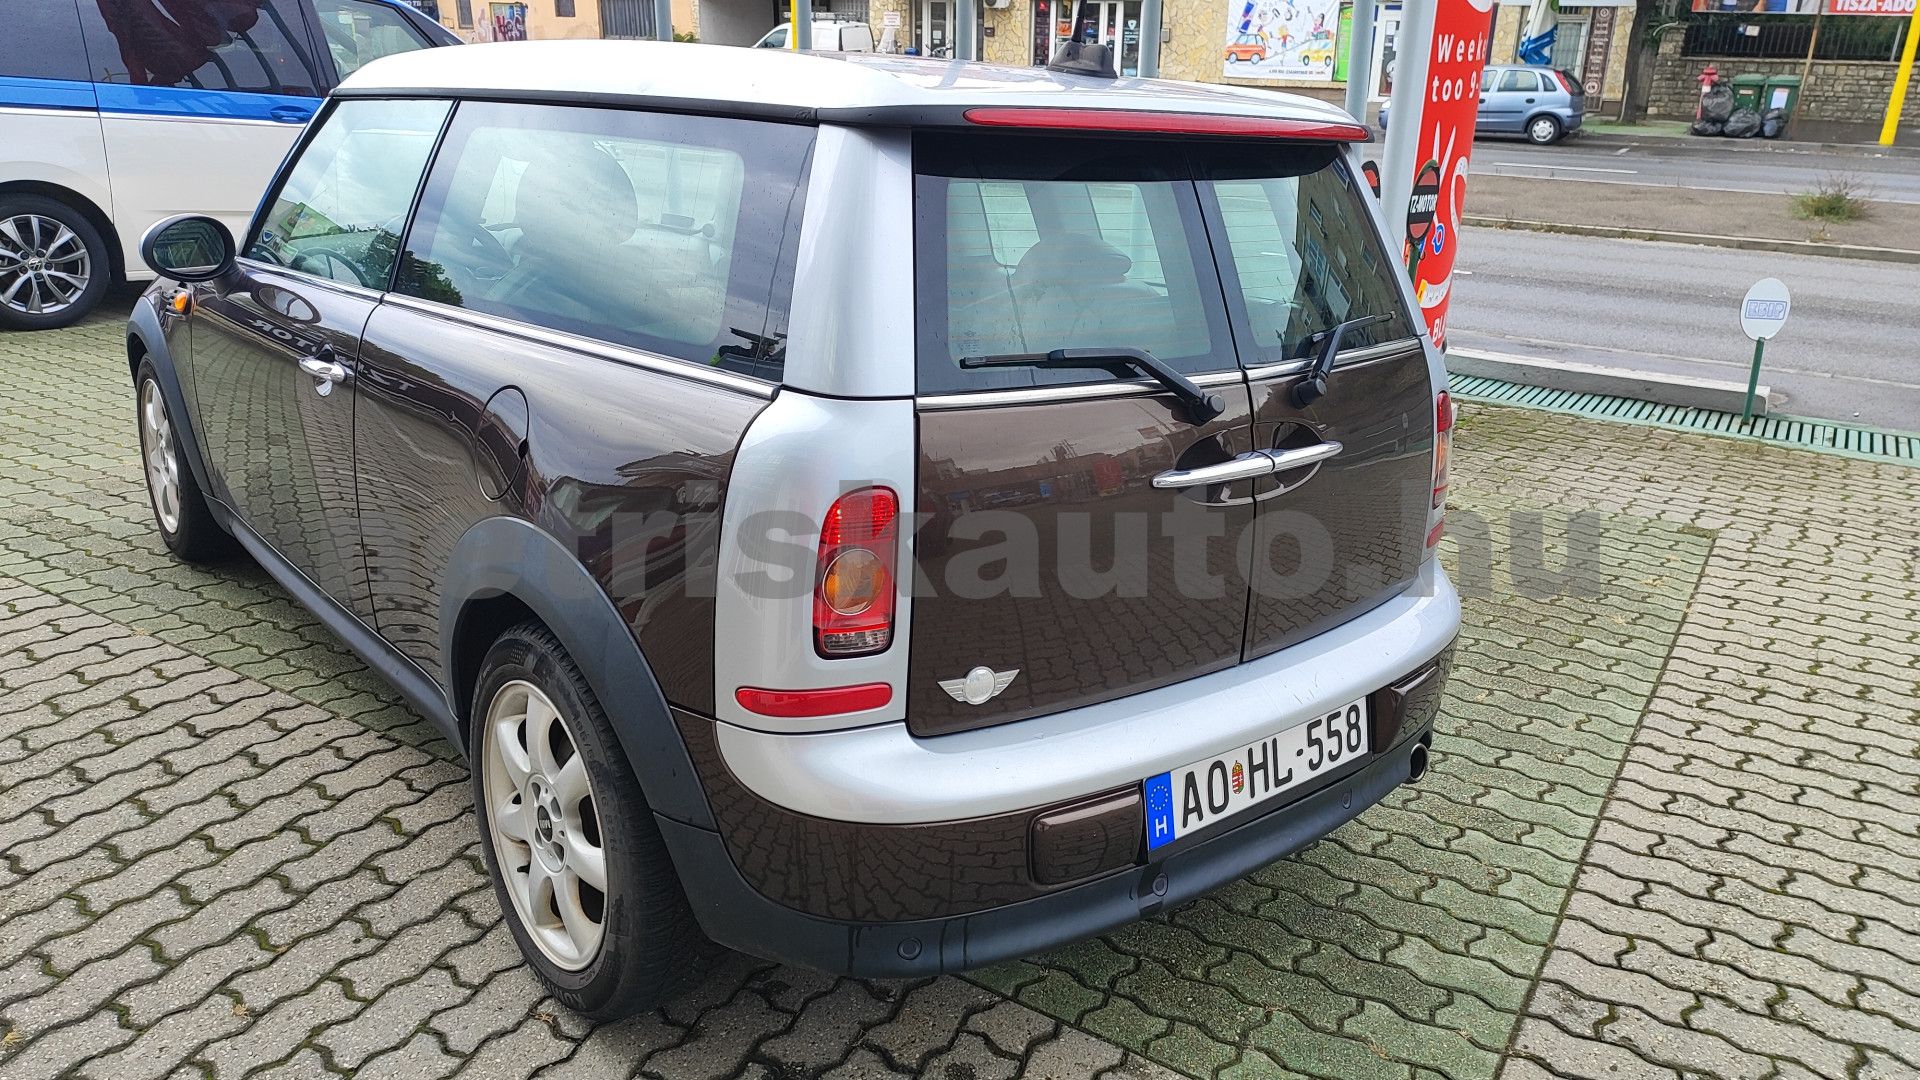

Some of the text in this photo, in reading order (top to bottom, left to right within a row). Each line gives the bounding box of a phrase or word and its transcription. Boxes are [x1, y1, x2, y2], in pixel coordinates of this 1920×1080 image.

[1432, 75, 1463, 102] too
[1409, 193, 1438, 214] TZ-MOTOR
[1181, 703, 1362, 828] AO HL-558
[1155, 814, 1168, 838] H
